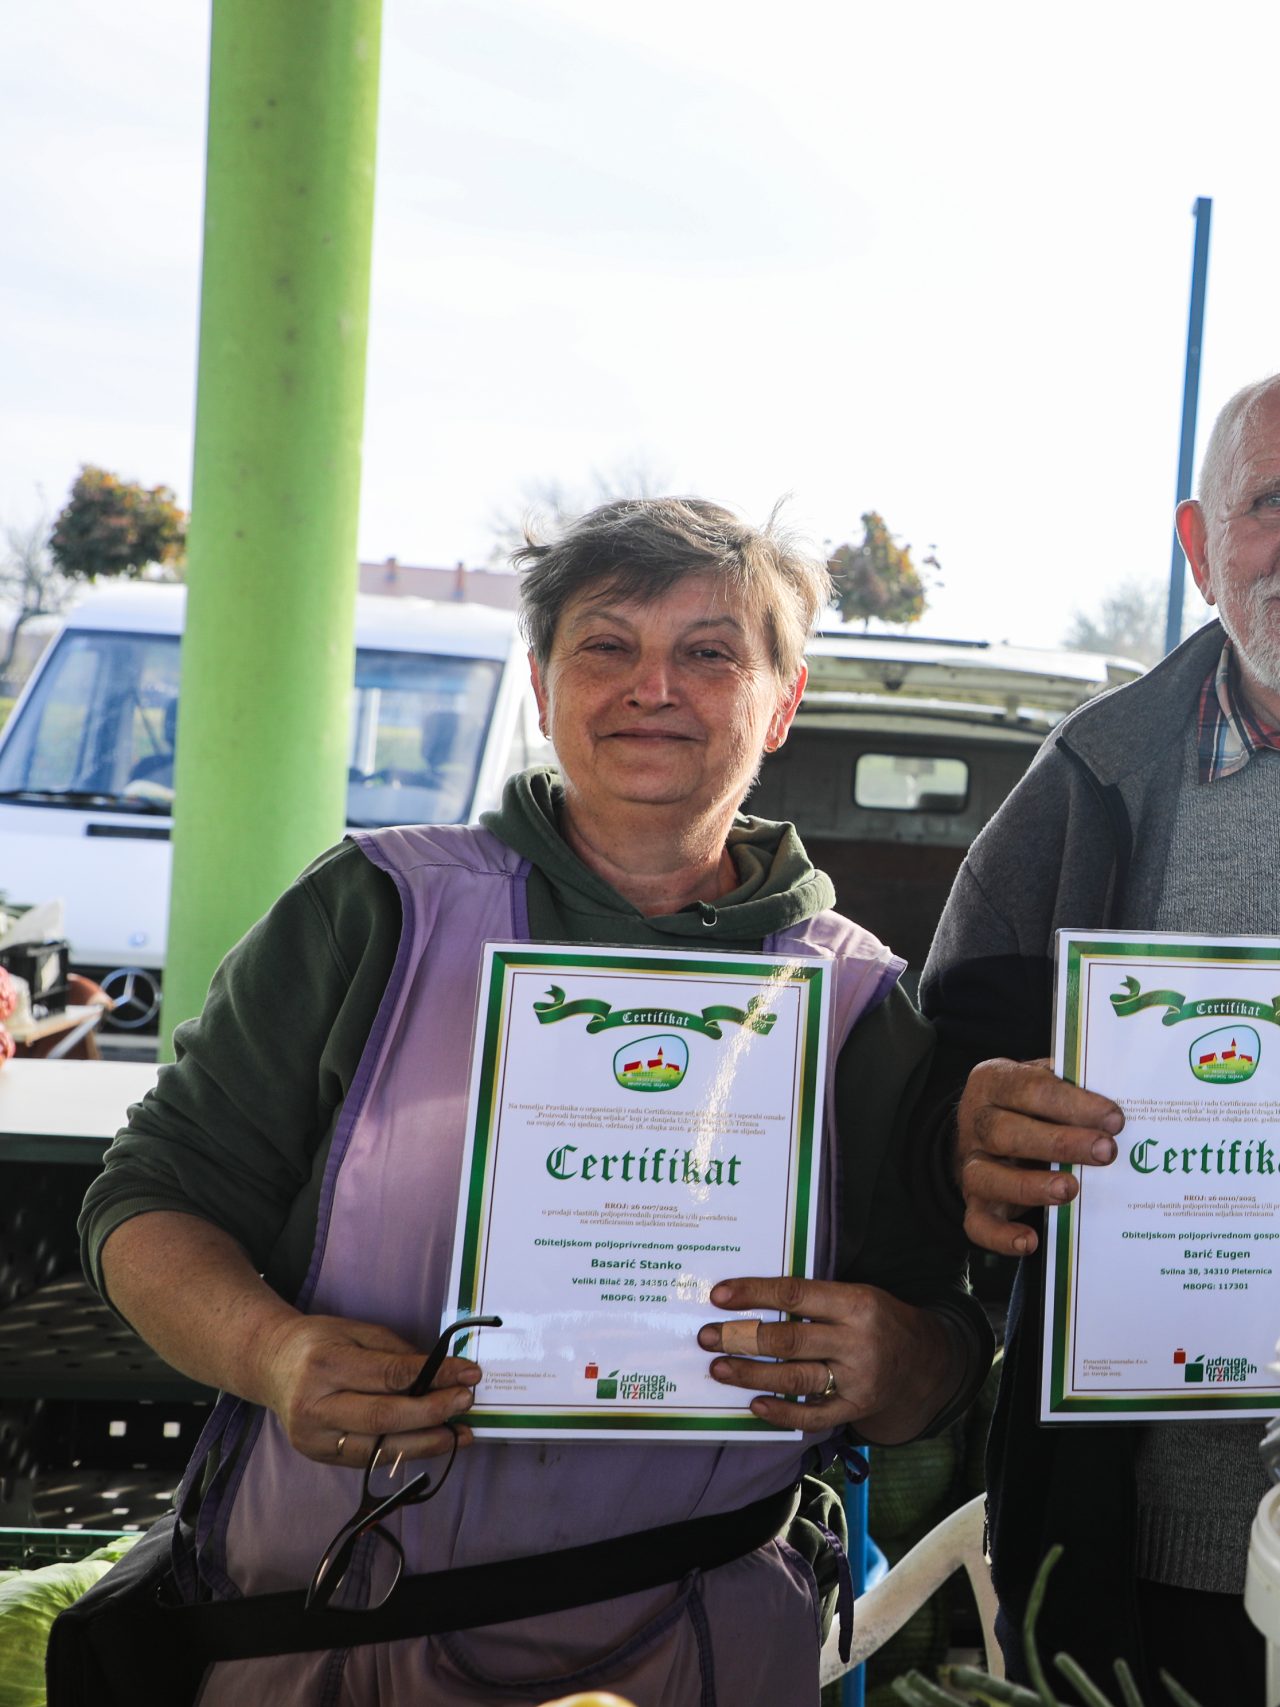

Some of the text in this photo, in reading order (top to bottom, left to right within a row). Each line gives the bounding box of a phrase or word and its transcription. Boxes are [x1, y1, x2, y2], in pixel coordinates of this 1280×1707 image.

[1196, 1002, 1261, 1016] Certifikat
[622, 1011, 690, 1027] Certifikat
[585, 1106, 622, 1114] organizaciji
[546, 1144, 741, 1186] Certifikat
[604, 1202, 628, 1210] BROJ:
[1122, 1231, 1176, 1240] Obiteljskom
[1178, 1231, 1251, 1241] poljoprivrednom
[534, 1238, 740, 1252] Obiteljskom poljoprivrednom gospodarstvu
[1184, 1249, 1250, 1260] Barić Eugen
[591, 1258, 682, 1270] Basarić Stanko
[1188, 1268, 1200, 1276] 38,
[572, 1277, 596, 1285] Veliki
[600, 1277, 620, 1286] Bilač
[640, 1278, 668, 1286] 34350
[600, 1294, 636, 1302] MBOPG:
[1208, 1356, 1248, 1368] udruga
[622, 1372, 666, 1384] udruga
[620, 1381, 676, 1392] hrvatskih
